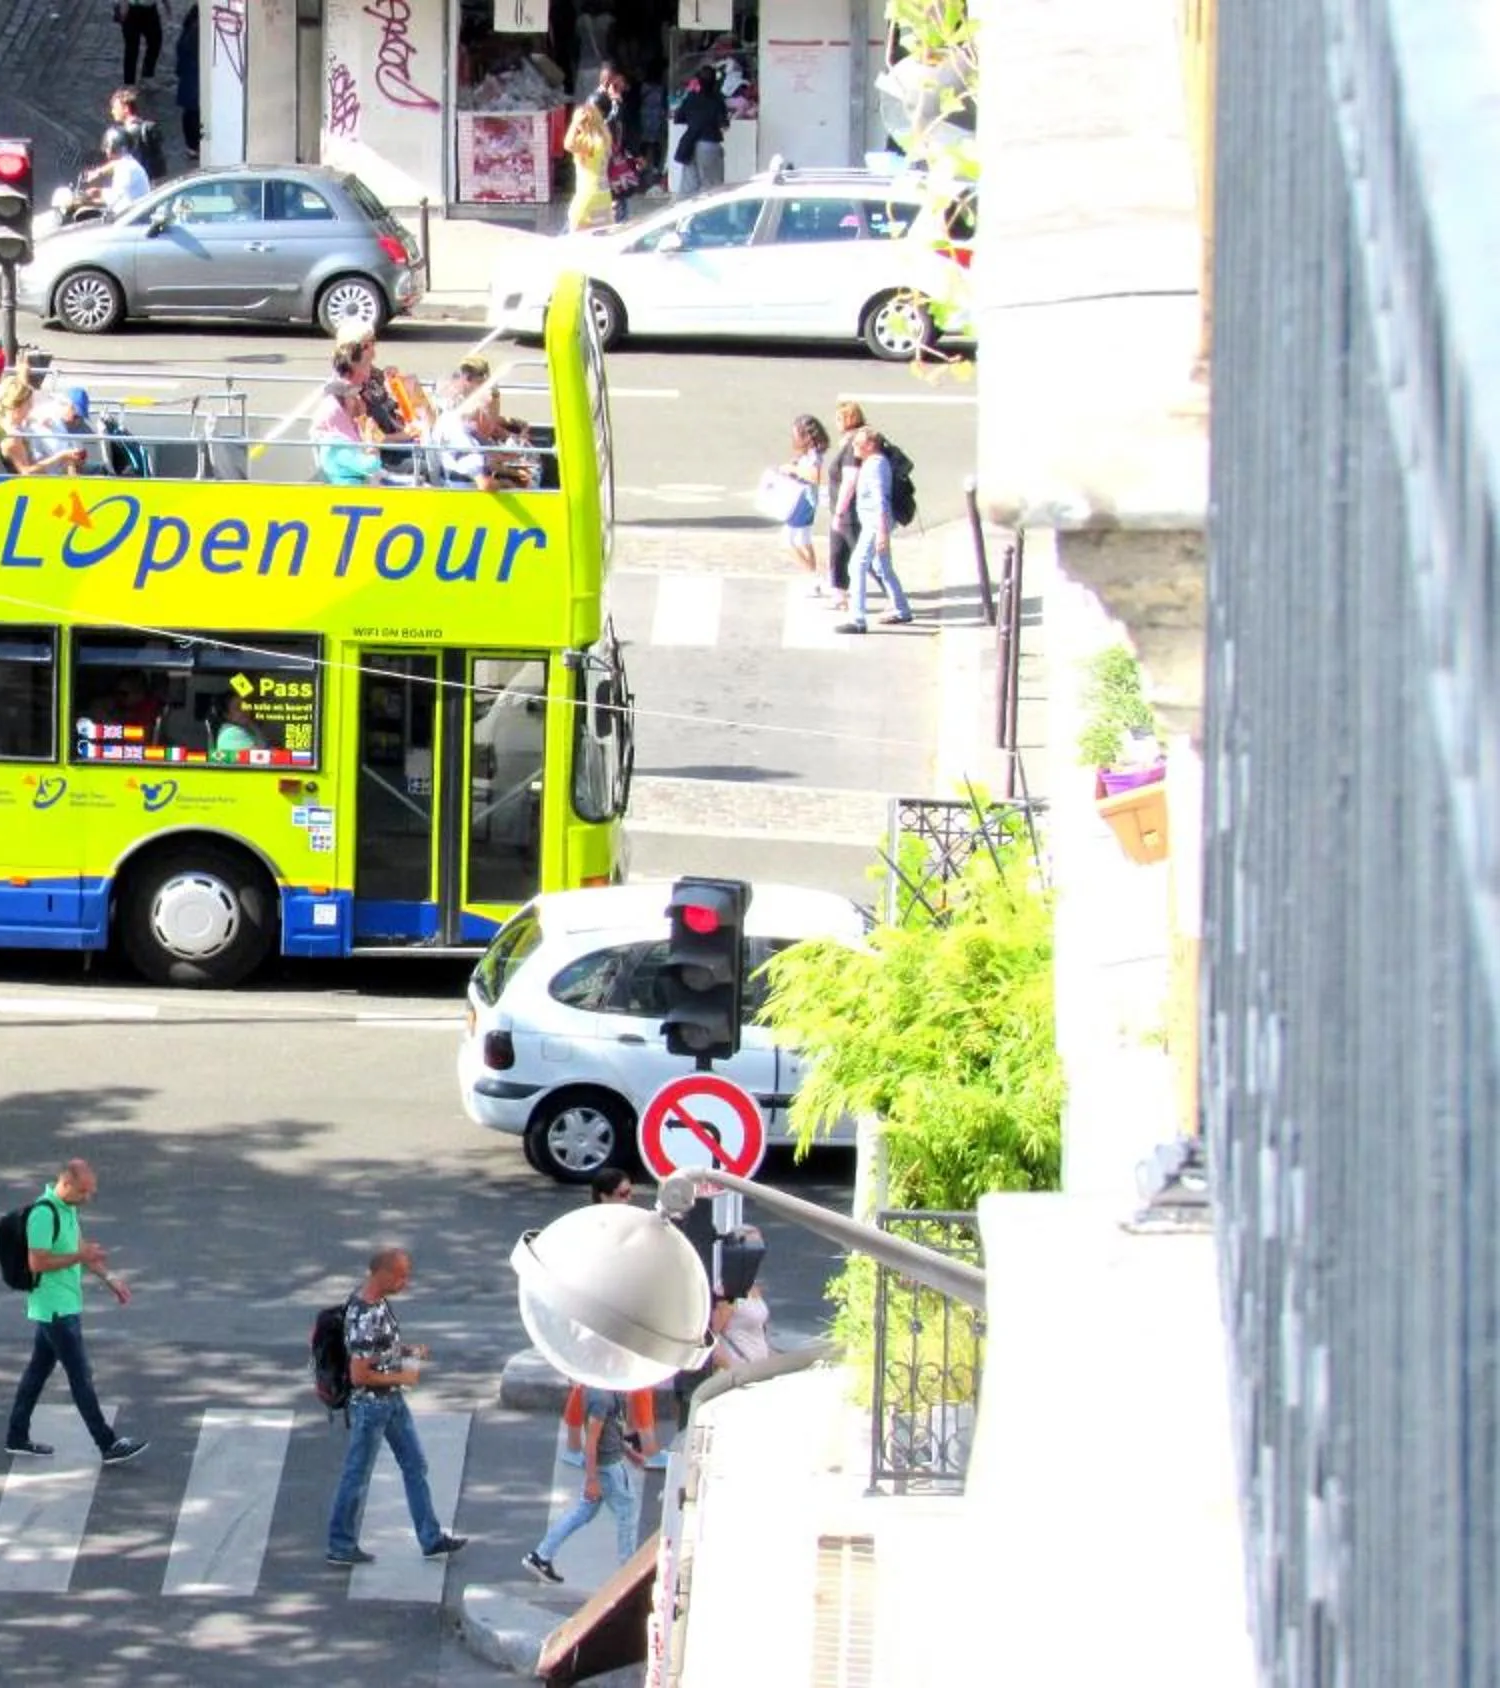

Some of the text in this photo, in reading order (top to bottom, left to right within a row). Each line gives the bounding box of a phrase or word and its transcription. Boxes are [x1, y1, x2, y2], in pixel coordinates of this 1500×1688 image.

[353, 627, 443, 639] WIFI ON BOARD
[260, 677, 313, 697] Pass
